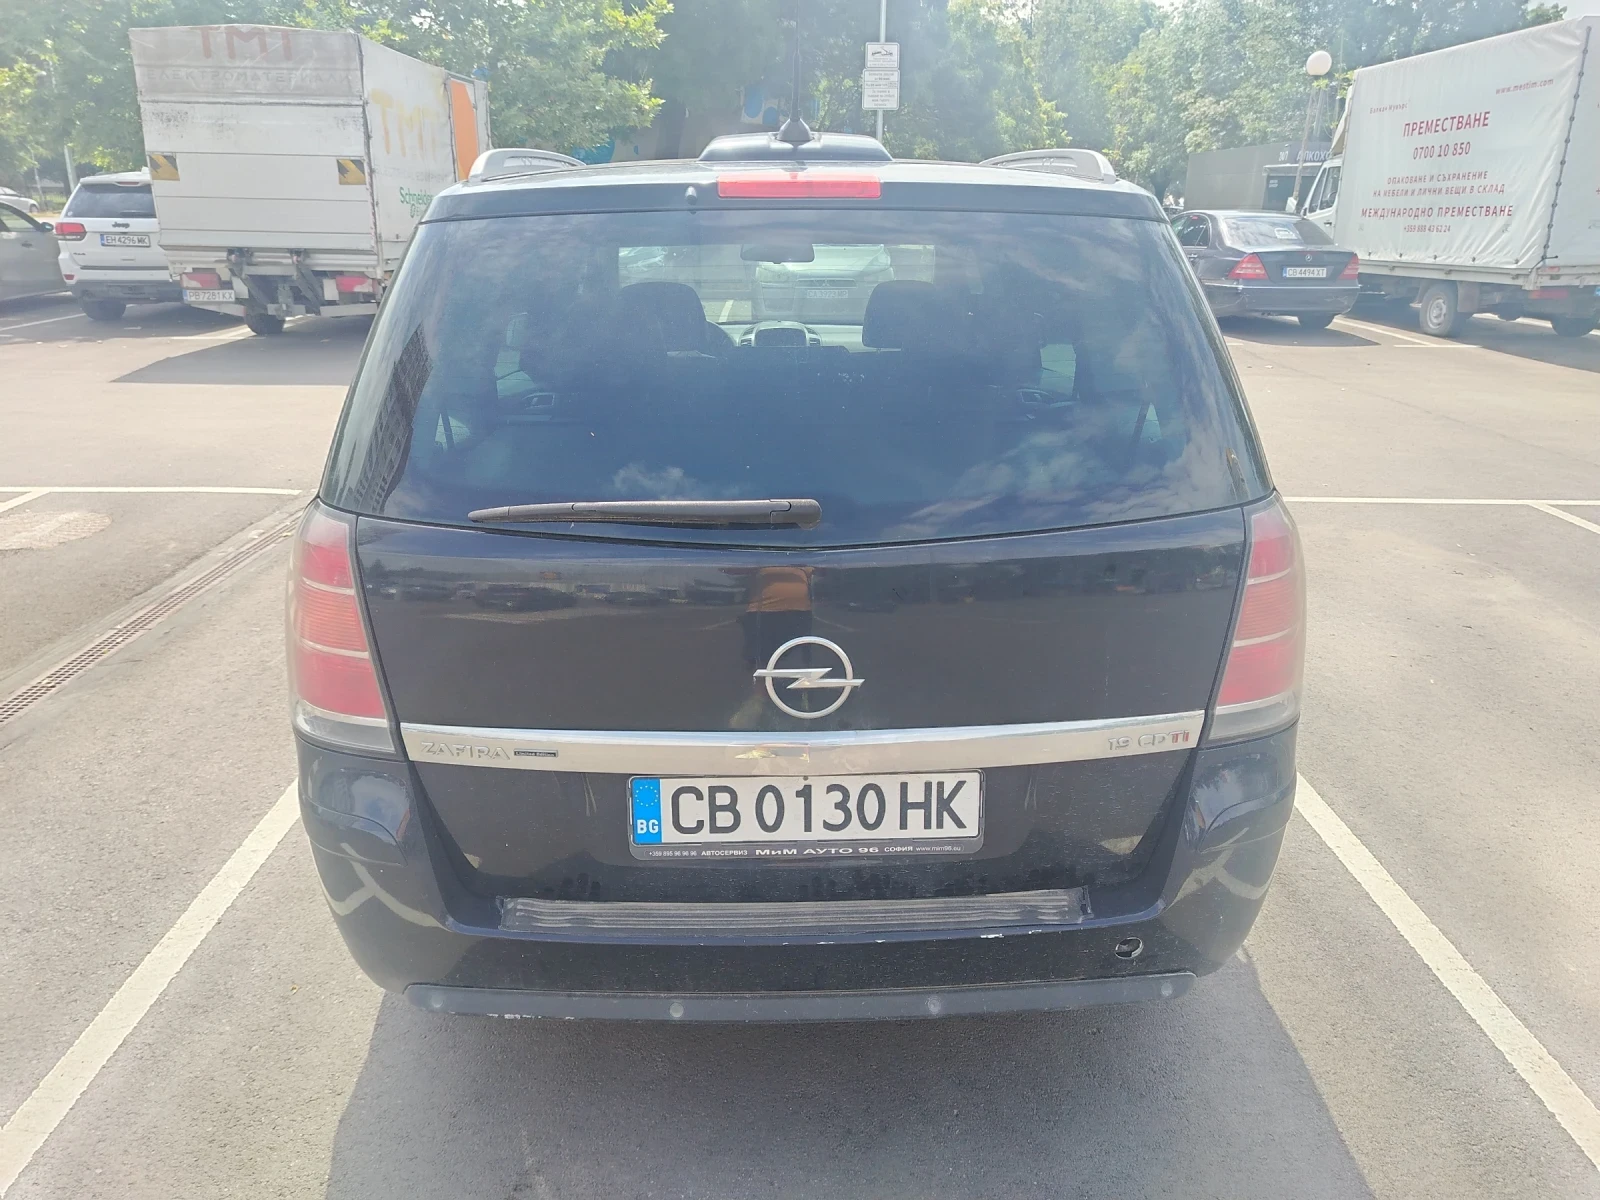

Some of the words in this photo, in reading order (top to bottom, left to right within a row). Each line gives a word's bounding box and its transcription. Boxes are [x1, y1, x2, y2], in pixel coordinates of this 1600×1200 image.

[1495, 79, 1554, 95] www.mestim.com
[1402, 110, 1490, 137] ПРЕМЕСТВАНЕ
[1413, 145, 1435, 160] 0700
[1437, 144, 1450, 158] 10
[1452, 141, 1471, 156] 850
[1387, 174, 1427, 185] ОПАКОВАНЕ
[1436, 171, 1488, 183] СЪХРАНЕНИЕ
[1373, 189, 1381, 198] НА
[1383, 189, 1409, 198] МЕБЕЛИ
[1410, 188, 1415, 196] И
[1416, 187, 1443, 196] ЛИЧНИ
[1445, 186, 1467, 197] ВЕЩИ
[1469, 185, 1475, 194] В
[1477, 184, 1506, 195] СКЛАД
[1361, 207, 1434, 220] МЕЖДУНАРОДНО
[1437, 205, 1513, 218] ПРЕМЕСТВАНЕ
[106, 235, 116, 244] EH
[119, 236, 136, 245] 4296
[137, 236, 148, 245] MK
[1287, 268, 1297, 277] CB
[1298, 268, 1315, 277] 4494
[1316, 268, 1325, 277] XT
[189, 291, 200, 300] PB
[201, 291, 221, 300] 7281
[222, 291, 233, 300] KX
[1138, 730, 1190, 747] CDTI
[420, 741, 511, 760] ZAFIRA
[636, 819, 659, 835] BG
[671, 785, 741, 835] CB
[755, 782, 886, 834] 0130
[899, 780, 967, 830] HK
[755, 848, 797, 856] МиМ
[884, 845, 913, 853] СОФИЯ
